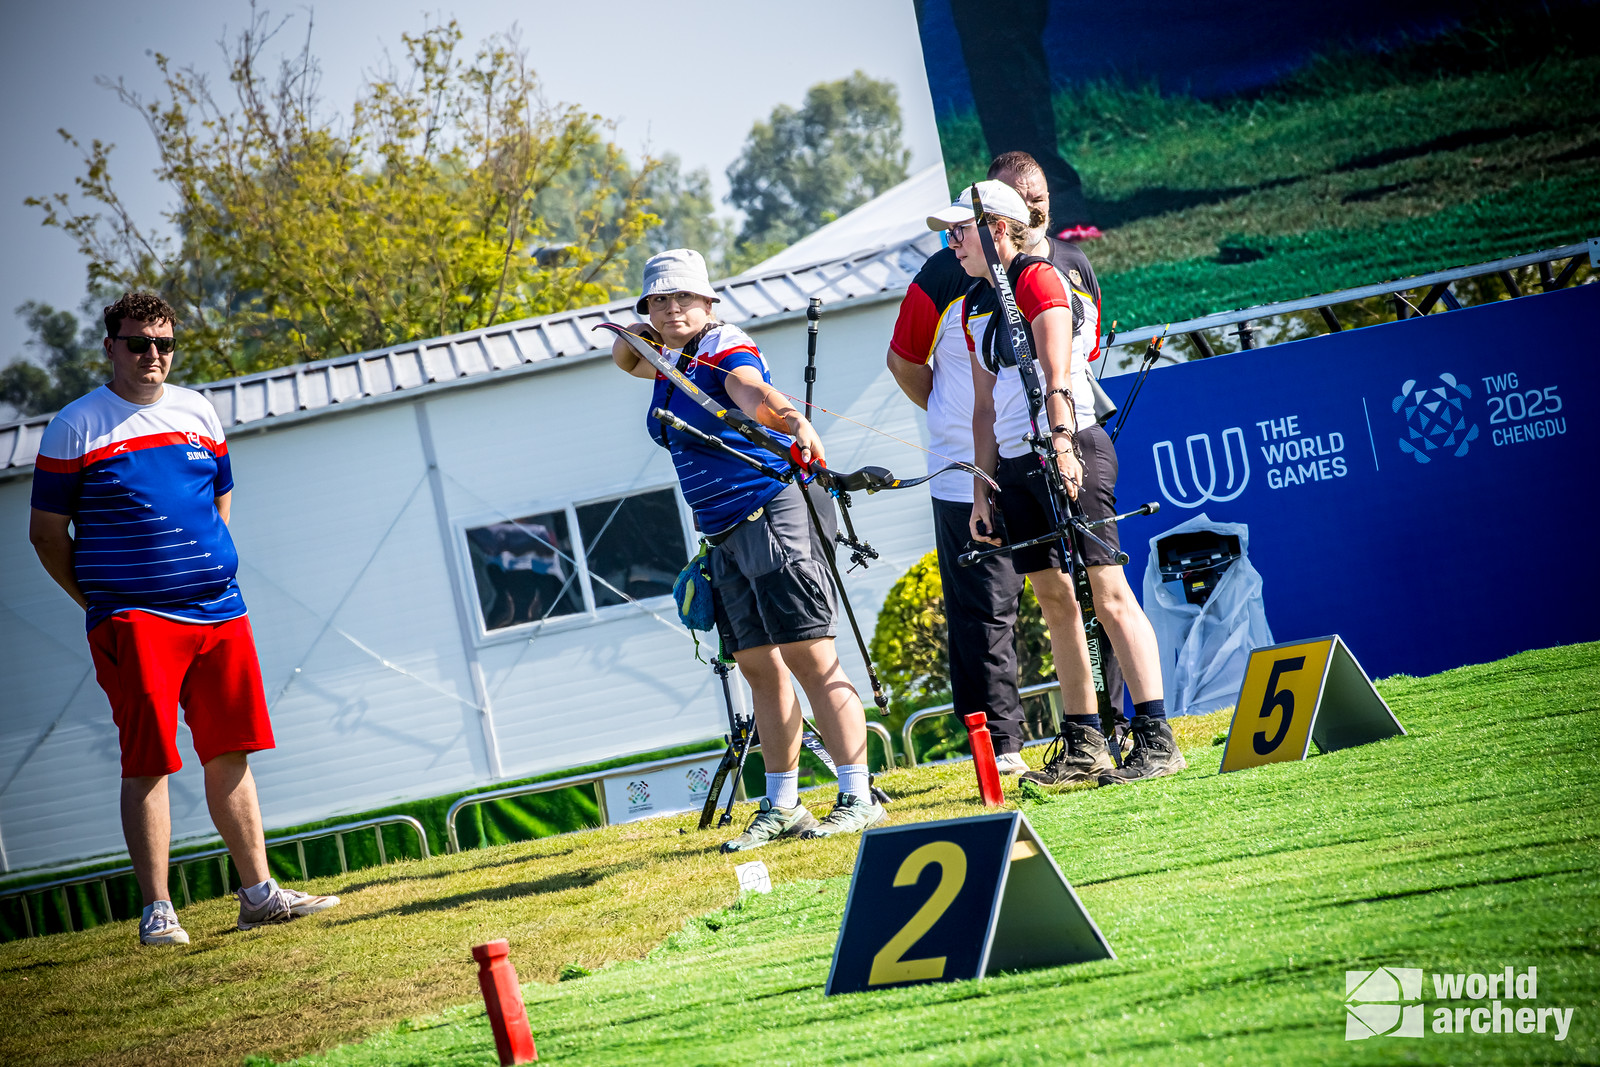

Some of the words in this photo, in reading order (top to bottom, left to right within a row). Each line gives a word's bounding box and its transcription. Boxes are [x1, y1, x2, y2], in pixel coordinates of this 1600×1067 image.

[992, 263, 1020, 325] WIAWIS
[1482, 372, 1519, 394] TWG
[1486, 385, 1563, 425] 2025
[1256, 415, 1301, 441] THE
[1492, 416, 1567, 446] CHENGDU
[1260, 432, 1345, 465] WORLD
[1267, 456, 1348, 490] GAMES
[1252, 655, 1306, 756] 5
[867, 840, 968, 986] 2
